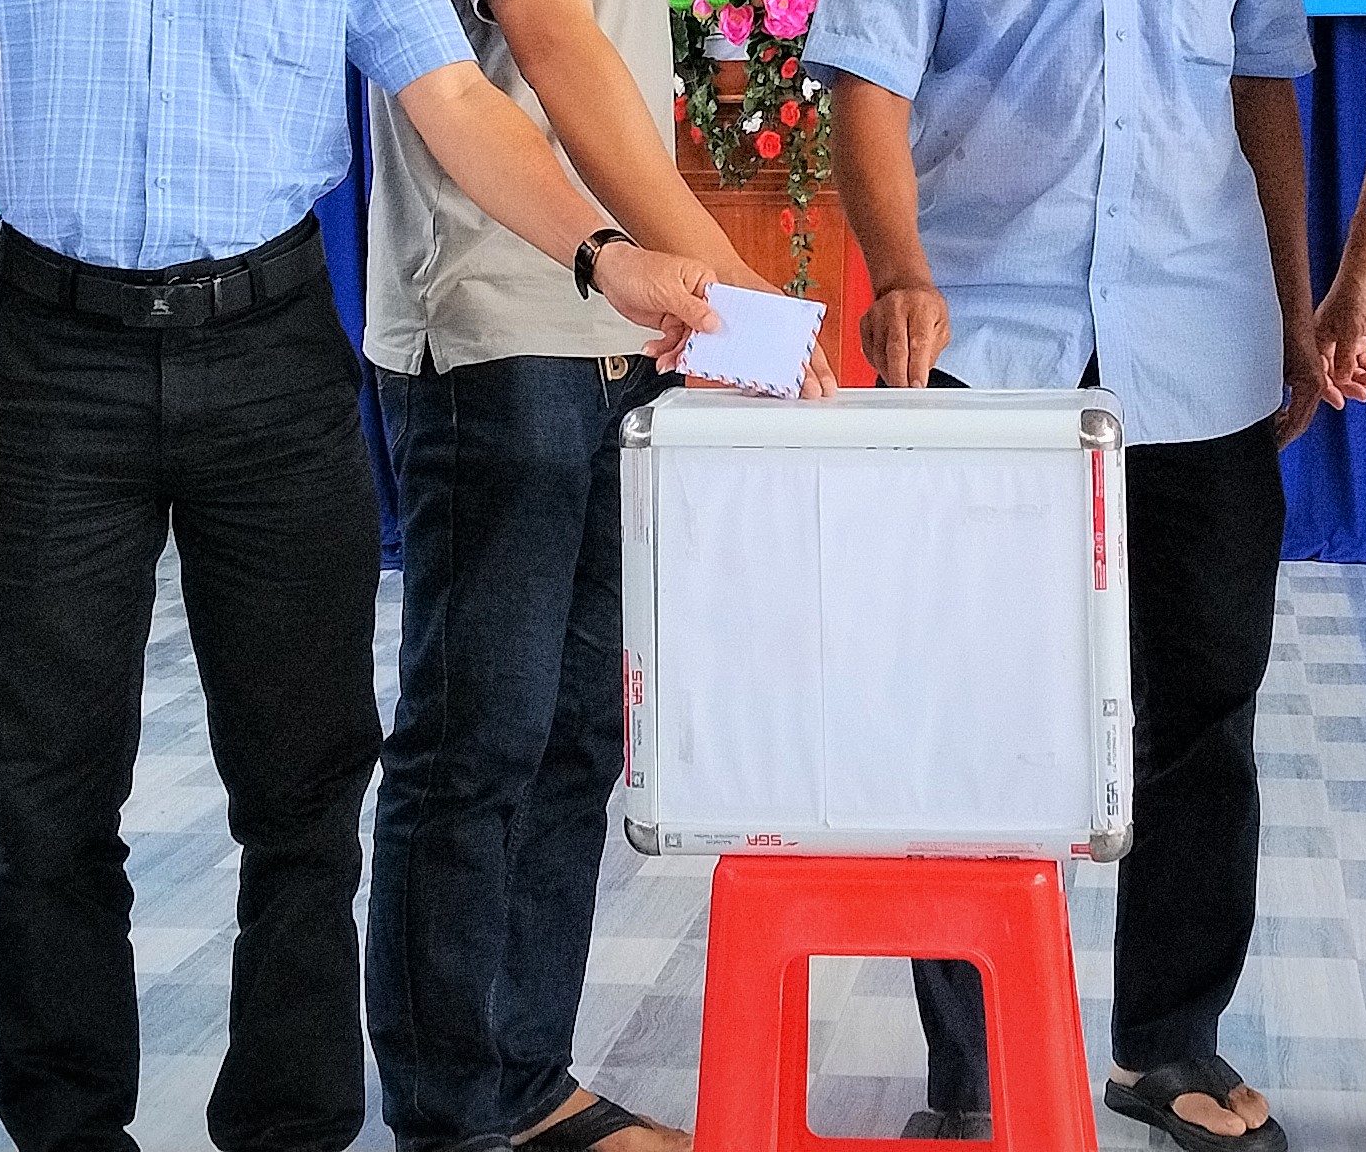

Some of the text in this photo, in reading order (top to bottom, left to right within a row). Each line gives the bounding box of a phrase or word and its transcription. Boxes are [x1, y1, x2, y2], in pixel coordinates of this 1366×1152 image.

[632, 670, 643, 706] SGA
[1106, 779, 1120, 816] SGA
[746, 834, 782, 847] SGA
